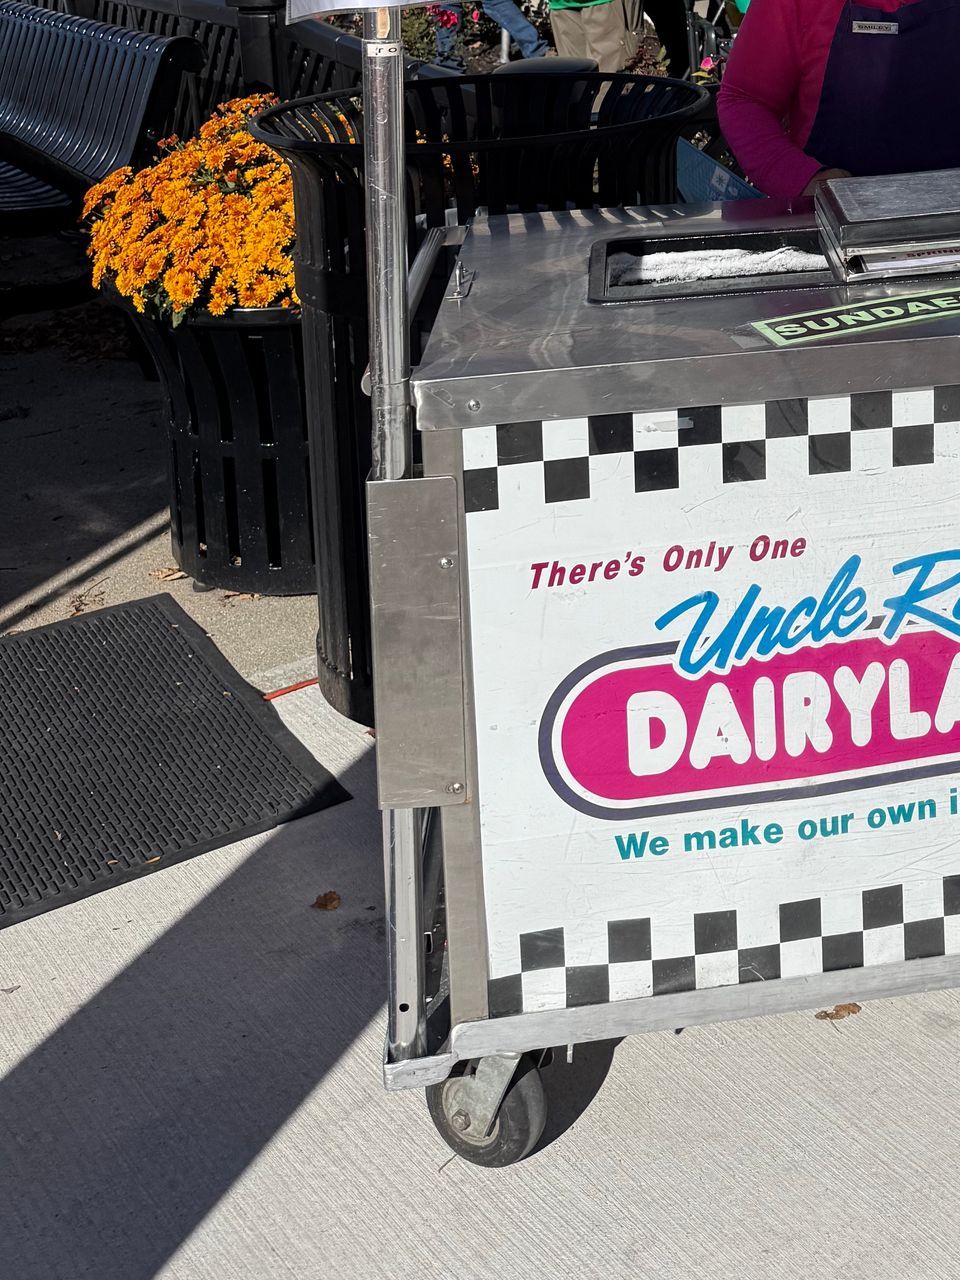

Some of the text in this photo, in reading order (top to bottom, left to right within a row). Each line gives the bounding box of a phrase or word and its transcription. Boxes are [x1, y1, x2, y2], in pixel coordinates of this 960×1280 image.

[530, 535, 807, 589] There's Only One
[655, 554, 868, 675] Uncle
[615, 832, 669, 861] We
[684, 818, 784, 852] make
[798, 814, 853, 841] our
[867, 798, 937, 829] own
